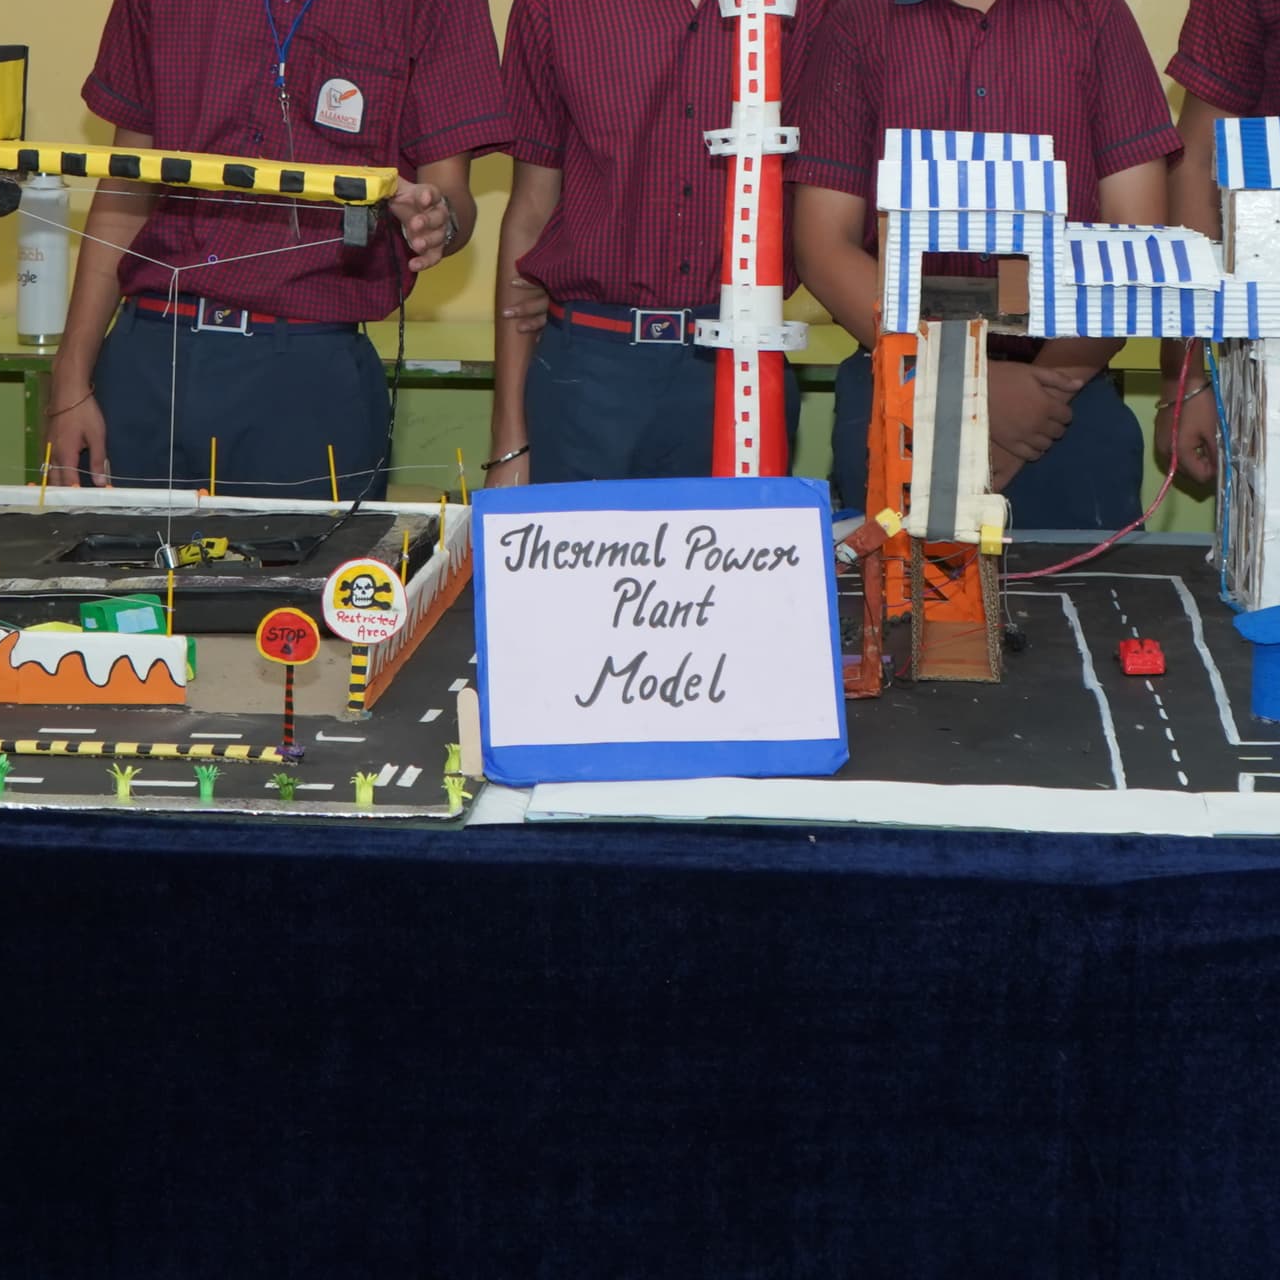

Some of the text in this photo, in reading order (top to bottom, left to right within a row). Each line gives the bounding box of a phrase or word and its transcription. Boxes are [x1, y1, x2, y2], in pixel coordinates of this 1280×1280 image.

[320, 110, 358, 124] ALLIANCE
[500, 522, 800, 572] Thermal Power
[613, 577, 716, 629] Plant
[336, 610, 398, 629] Restricted
[266, 627, 306, 644] STOP
[357, 624, 387, 640] Area
[574, 651, 727, 708] Model
